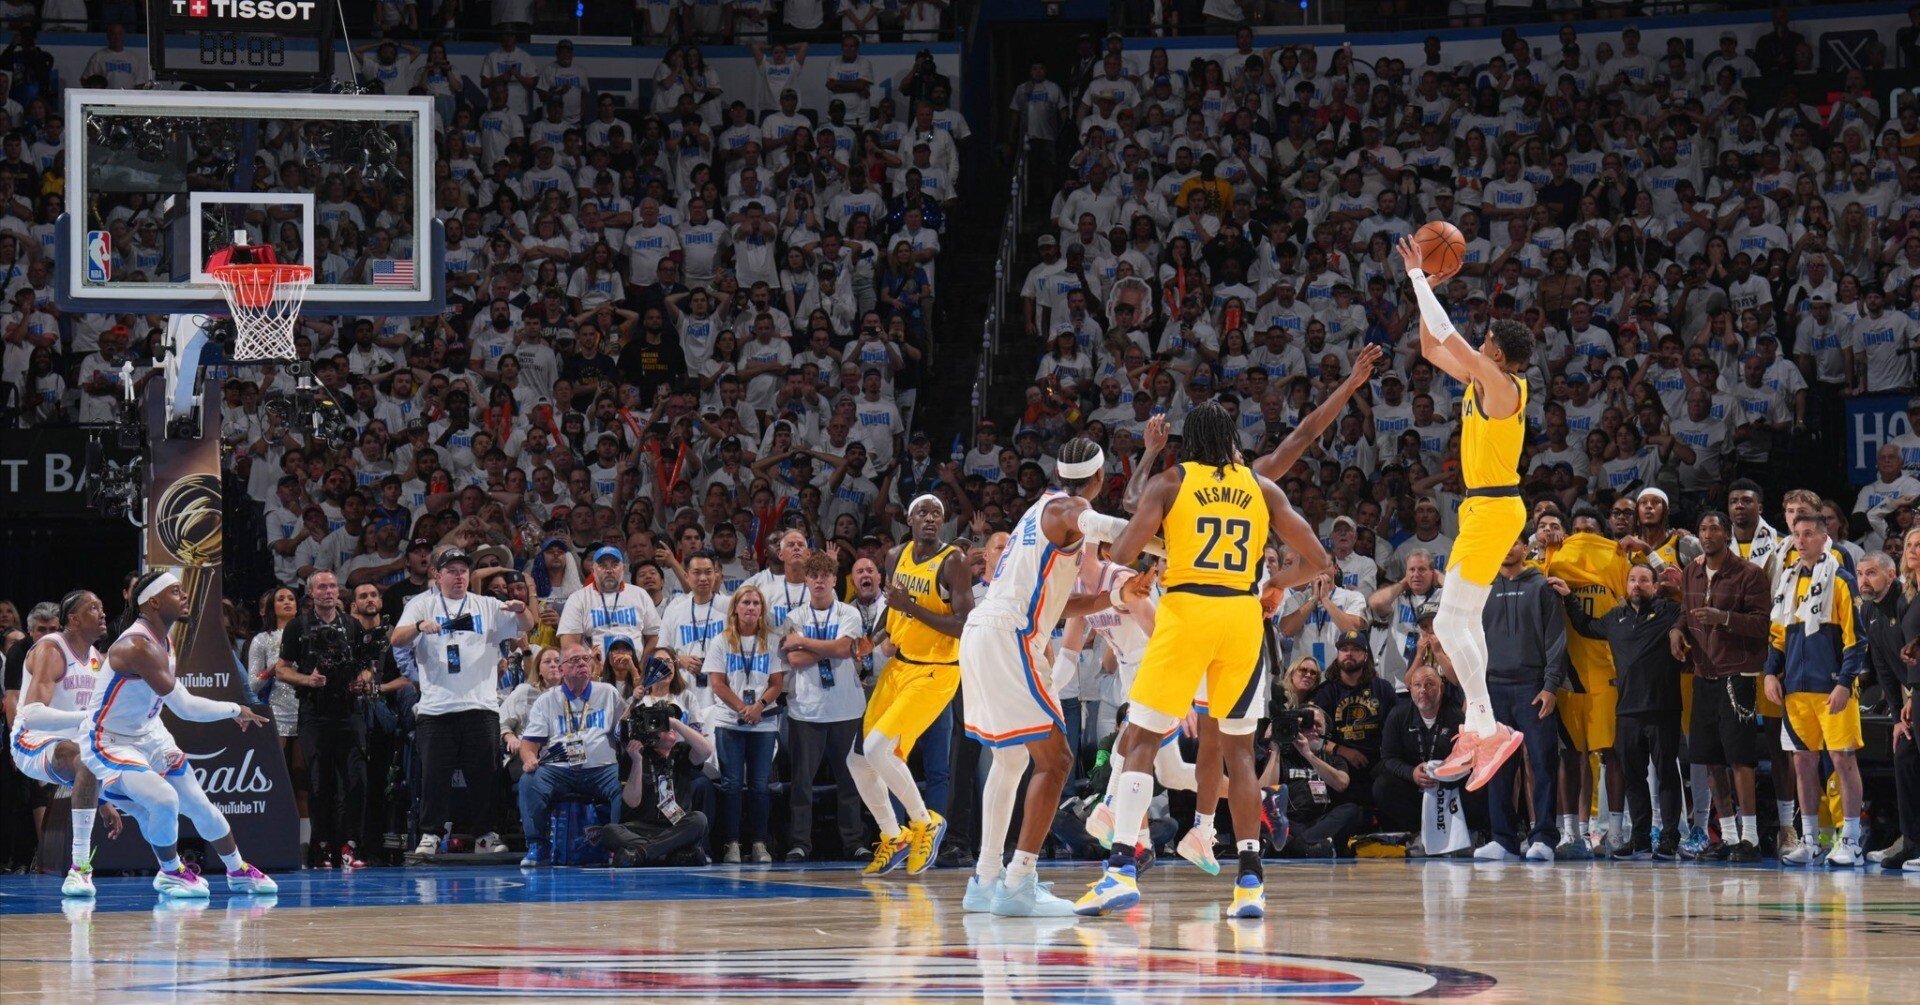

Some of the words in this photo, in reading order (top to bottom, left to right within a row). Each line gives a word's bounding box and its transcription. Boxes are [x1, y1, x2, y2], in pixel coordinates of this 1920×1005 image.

[212, 0, 315, 20] TISSOT
[1496, 190, 1523, 204] THUNDER
[685, 233, 713, 244] THUNDER
[1740, 237, 1767, 250] THUNDER
[1271, 316, 1301, 330] THUNDER
[1862, 329, 1894, 346] THUNDER
[1653, 377, 1685, 391] THUNDER
[860, 412, 890, 426] THUNDER
[1377, 418, 1410, 433] THUNDER
[1194, 486, 1253, 510] NESMITH
[1194, 516, 1251, 572] 23
[726, 652, 770, 675] THUNDER
[214, 673, 230, 688] TV
[252, 801, 266, 814] TV
